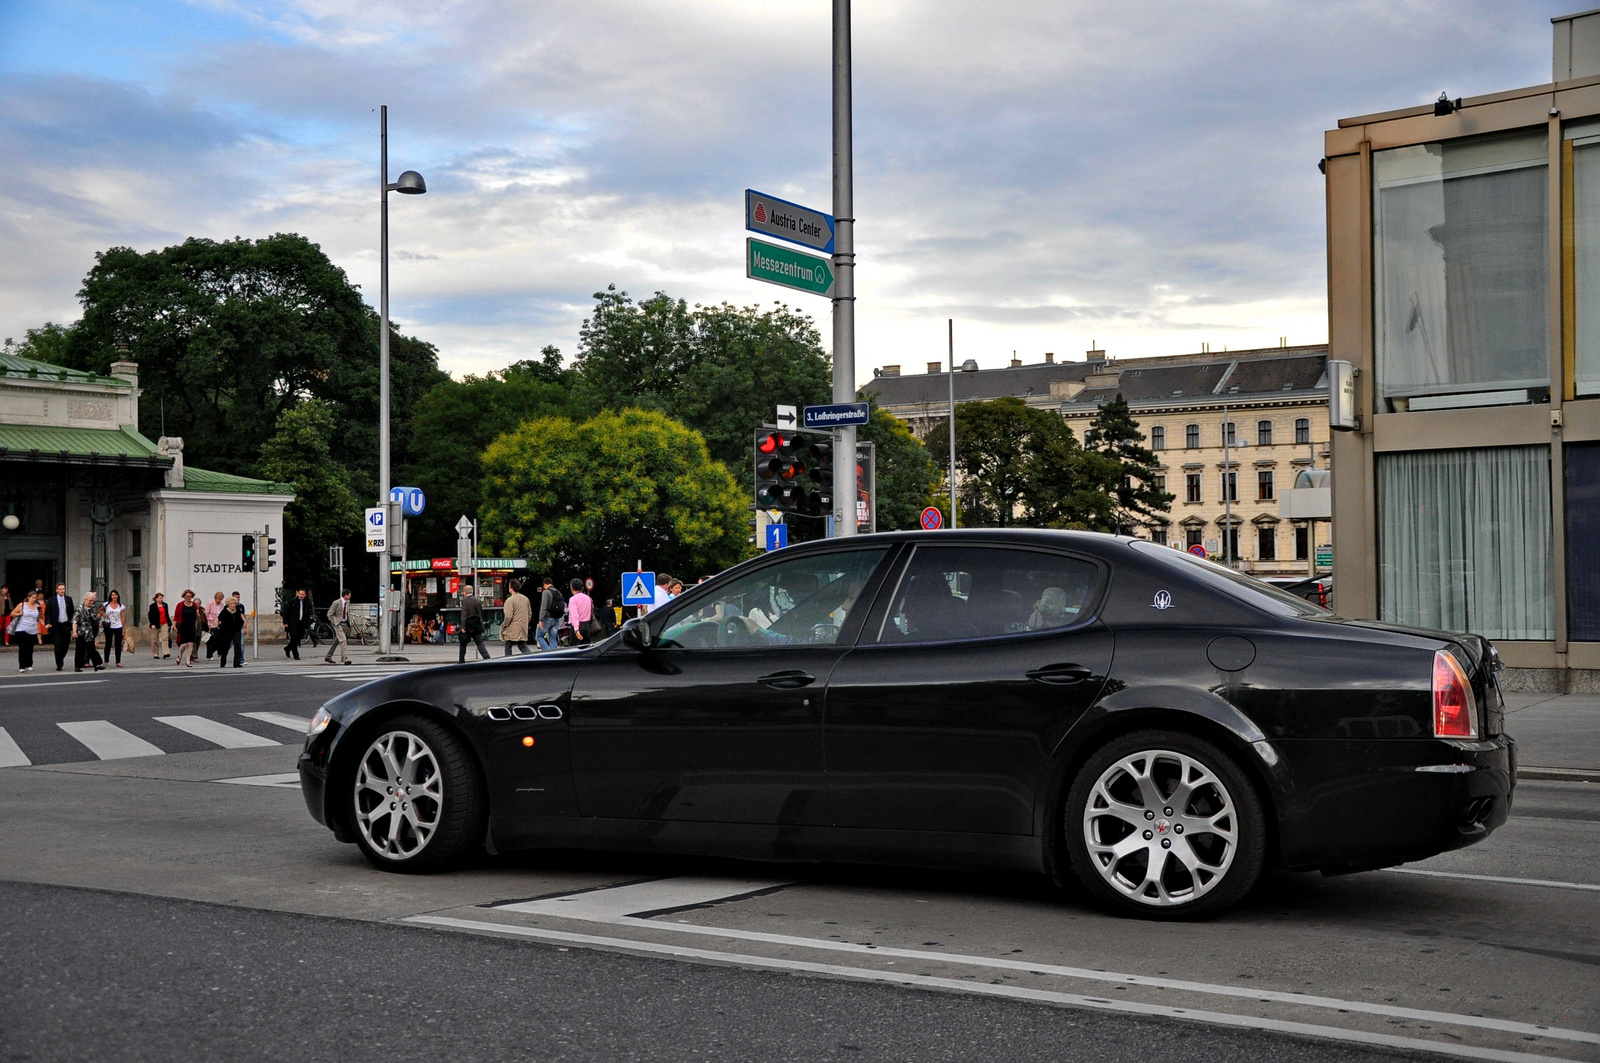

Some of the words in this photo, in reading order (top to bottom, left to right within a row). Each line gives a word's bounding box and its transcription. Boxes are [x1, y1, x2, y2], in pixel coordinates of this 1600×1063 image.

[770, 209, 796, 231] Austria
[798, 218, 822, 238] Center
[753, 250, 813, 282] Messezentrum
[814, 409, 865, 421] Lothringerstraße
[410, 492, 423, 512] U
[375, 513, 382, 525] P
[773, 528, 780, 542] 1
[193, 563, 255, 573] STADTPA
